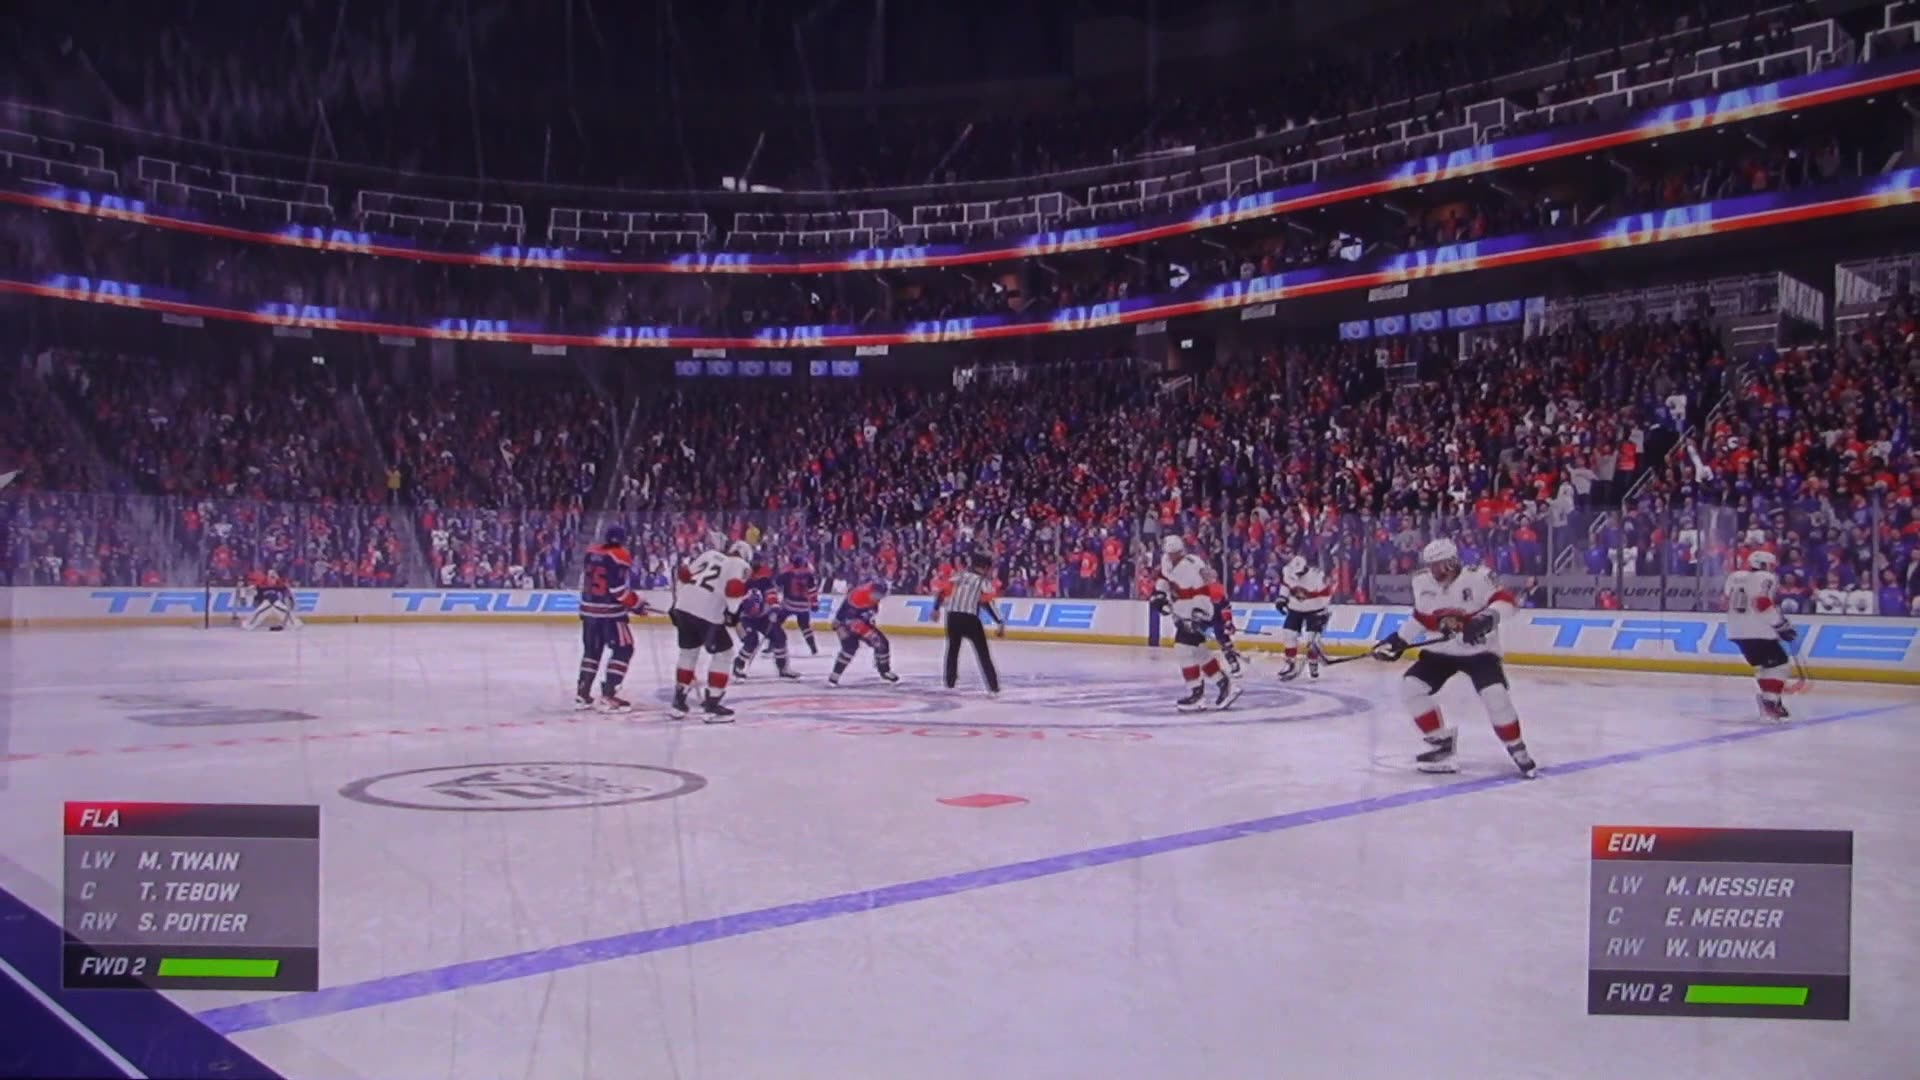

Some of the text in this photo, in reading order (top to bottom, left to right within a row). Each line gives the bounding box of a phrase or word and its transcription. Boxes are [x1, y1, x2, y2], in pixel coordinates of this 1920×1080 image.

[80, 809, 118, 827] FLA
[81, 851, 239, 870] LW M. TWAIN
[81, 882, 240, 901] C T. TEBOW
[1608, 876, 1794, 897] LW M. MESSIER
[81, 912, 247, 932] RW S. POITIER
[1608, 907, 1783, 928] C E. MERCER
[1607, 937, 1775, 959] RW W. WONKA
[81, 957, 146, 975] FWD 2
[1607, 983, 1673, 1002] FWD 2
